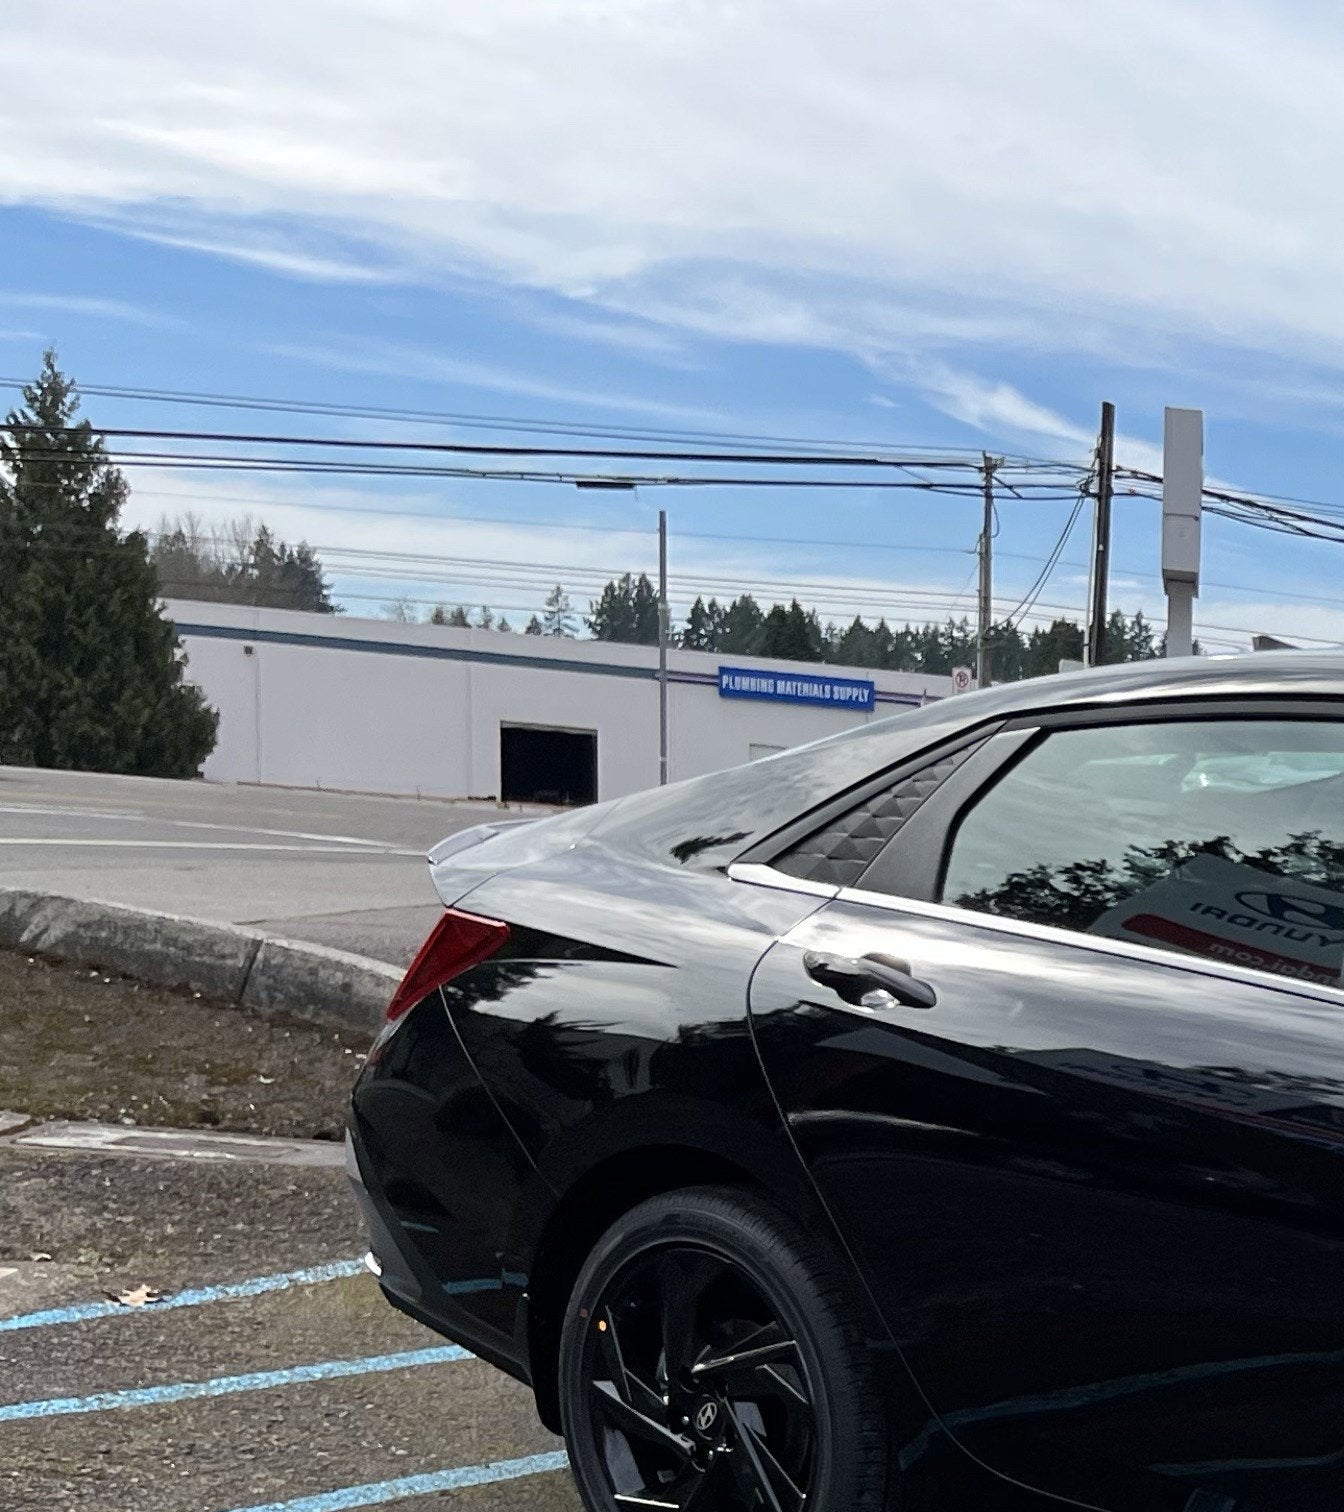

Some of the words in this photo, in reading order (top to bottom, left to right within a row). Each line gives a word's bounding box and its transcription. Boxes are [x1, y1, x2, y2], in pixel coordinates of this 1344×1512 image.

[722, 674, 774, 694] PLUMBING
[776, 679, 831, 699] MATERIALS
[833, 685, 870, 703] SUPPLY
